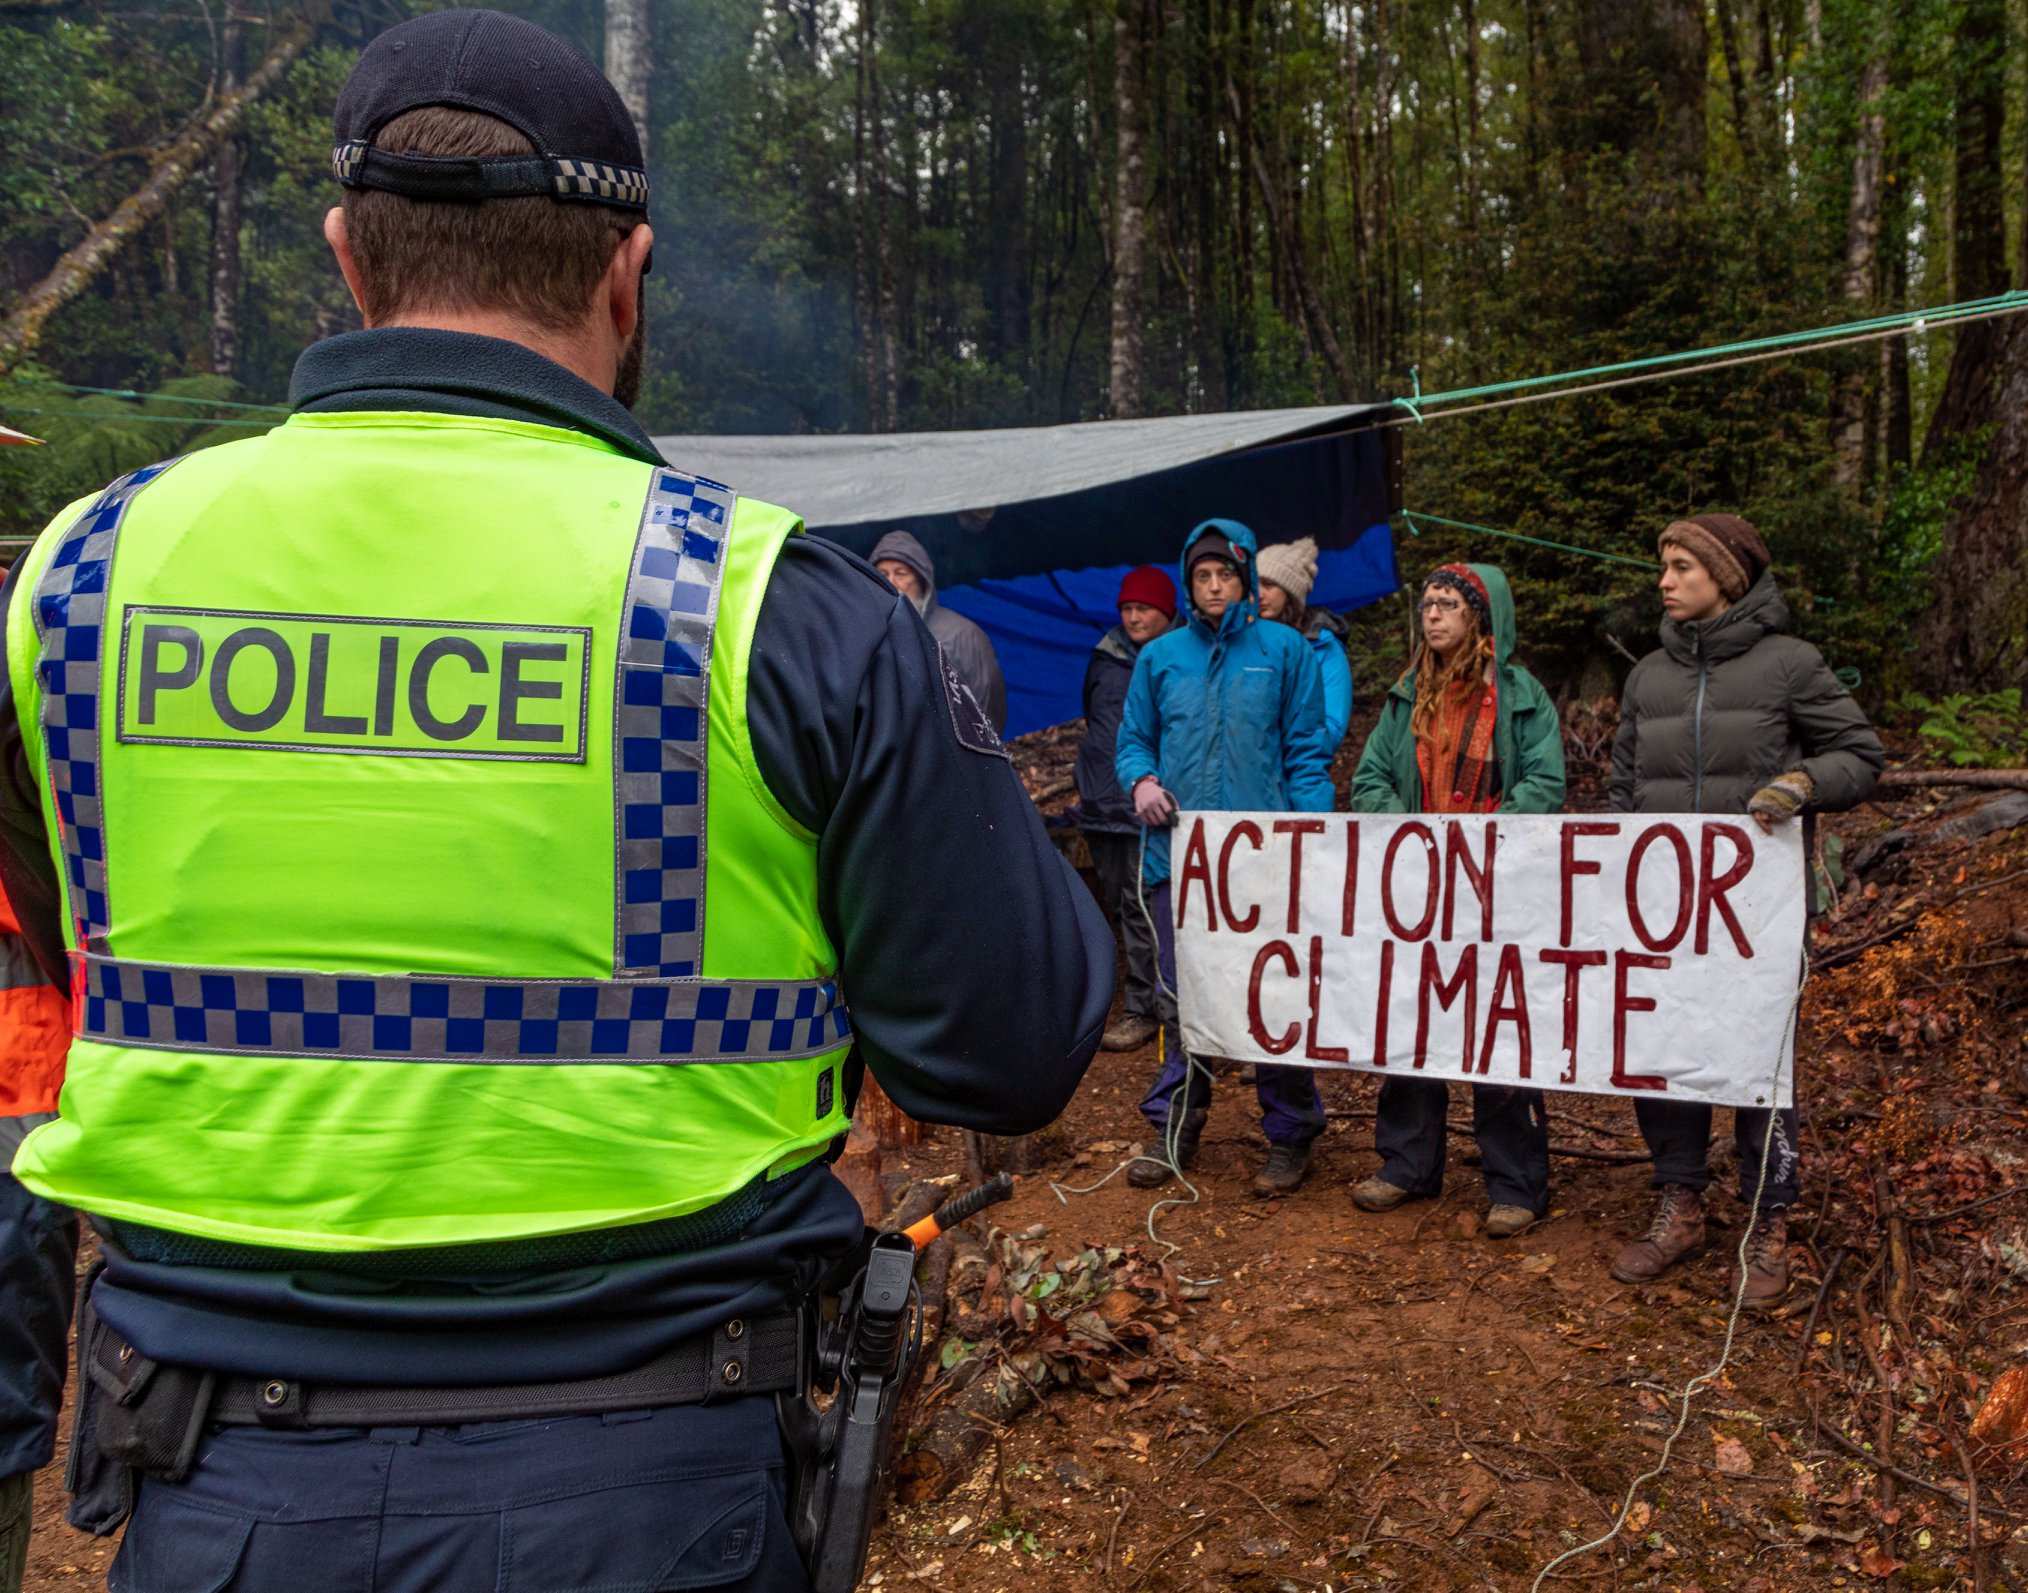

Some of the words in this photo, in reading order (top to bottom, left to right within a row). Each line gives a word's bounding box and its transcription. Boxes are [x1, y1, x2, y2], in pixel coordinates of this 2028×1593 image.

[138, 624, 568, 742] POLICE
[1178, 817, 1498, 942] ACTION
[1561, 822, 1755, 959] FOR
[1247, 935, 1672, 1091] CLIMATE
